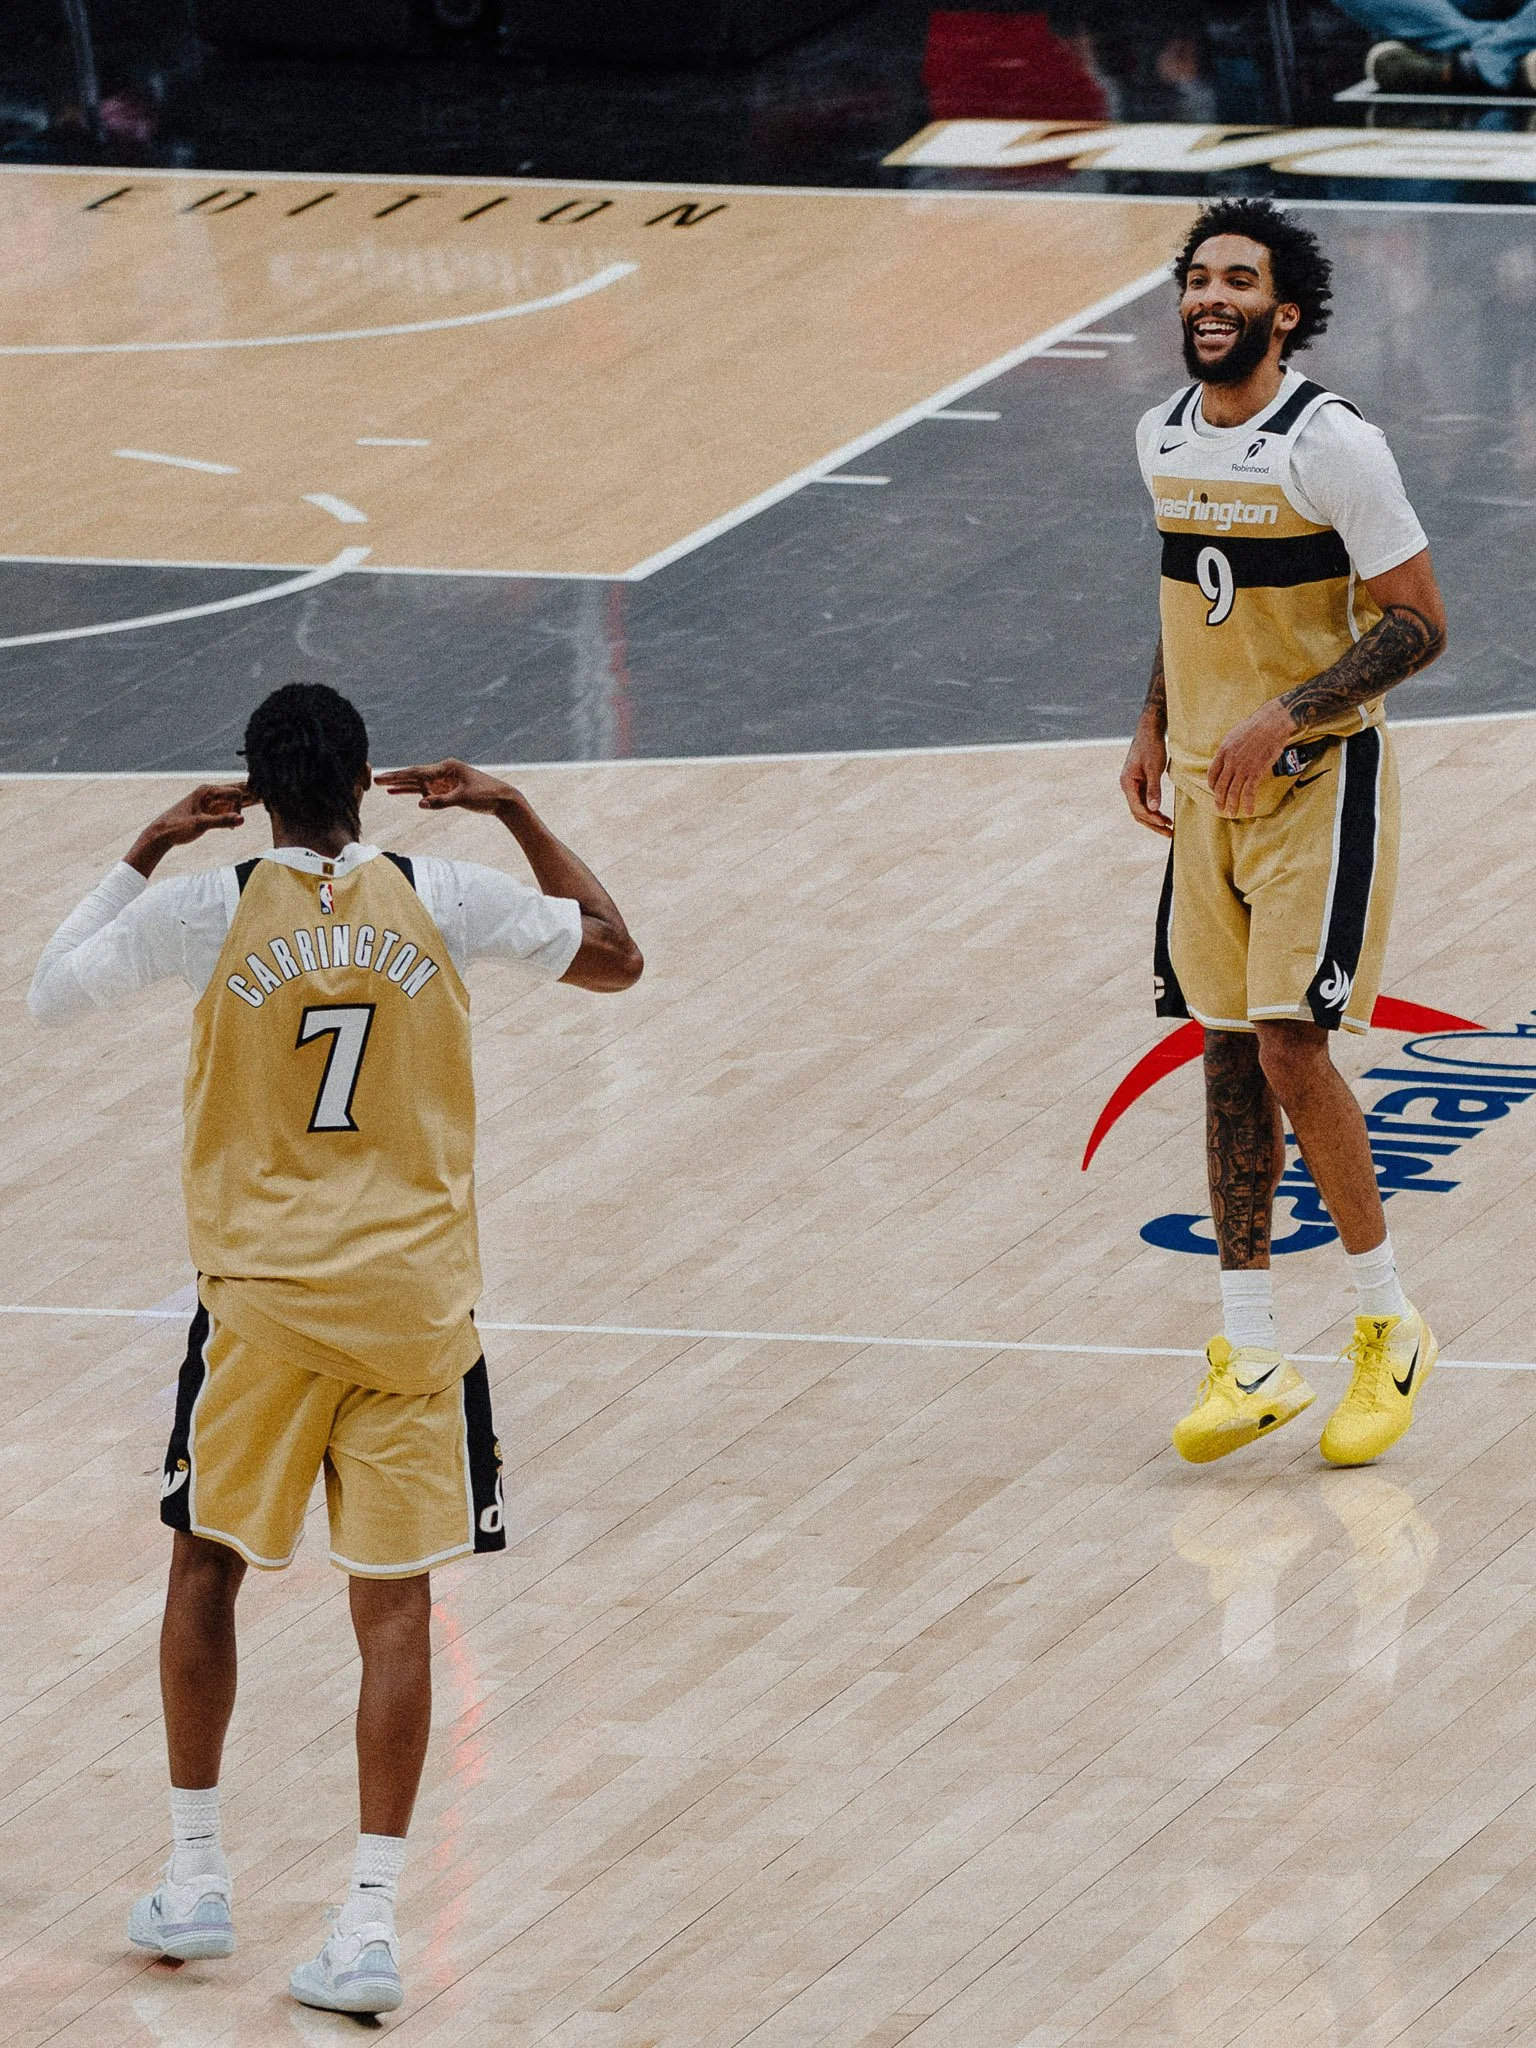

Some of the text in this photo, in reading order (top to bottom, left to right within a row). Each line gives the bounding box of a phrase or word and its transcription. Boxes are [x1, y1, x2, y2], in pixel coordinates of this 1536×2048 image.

[83, 186, 730, 227] EDITION
[1231, 463, 1269, 474] Robinhood
[1196, 546, 1236, 626] 9
[226, 924, 439, 1009] CARRINGTON
[295, 1003, 377, 1133] 7
